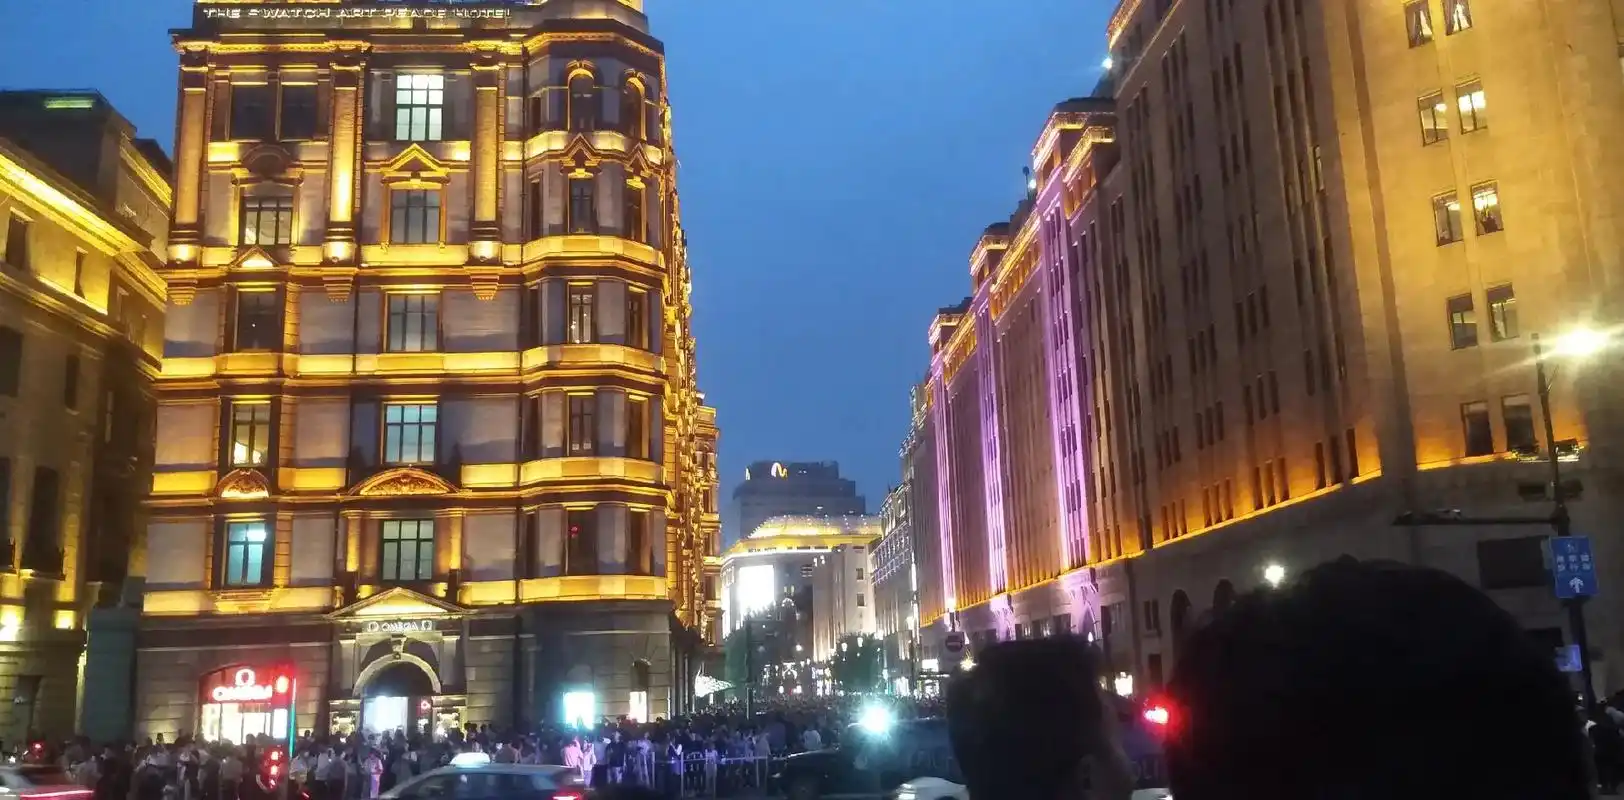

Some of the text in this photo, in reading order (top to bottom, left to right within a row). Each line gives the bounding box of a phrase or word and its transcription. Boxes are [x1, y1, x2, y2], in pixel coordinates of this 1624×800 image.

[203, 8, 511, 18] THE SWATCH ART PEACE HOTEL
[381, 622, 419, 632] OMEGA
